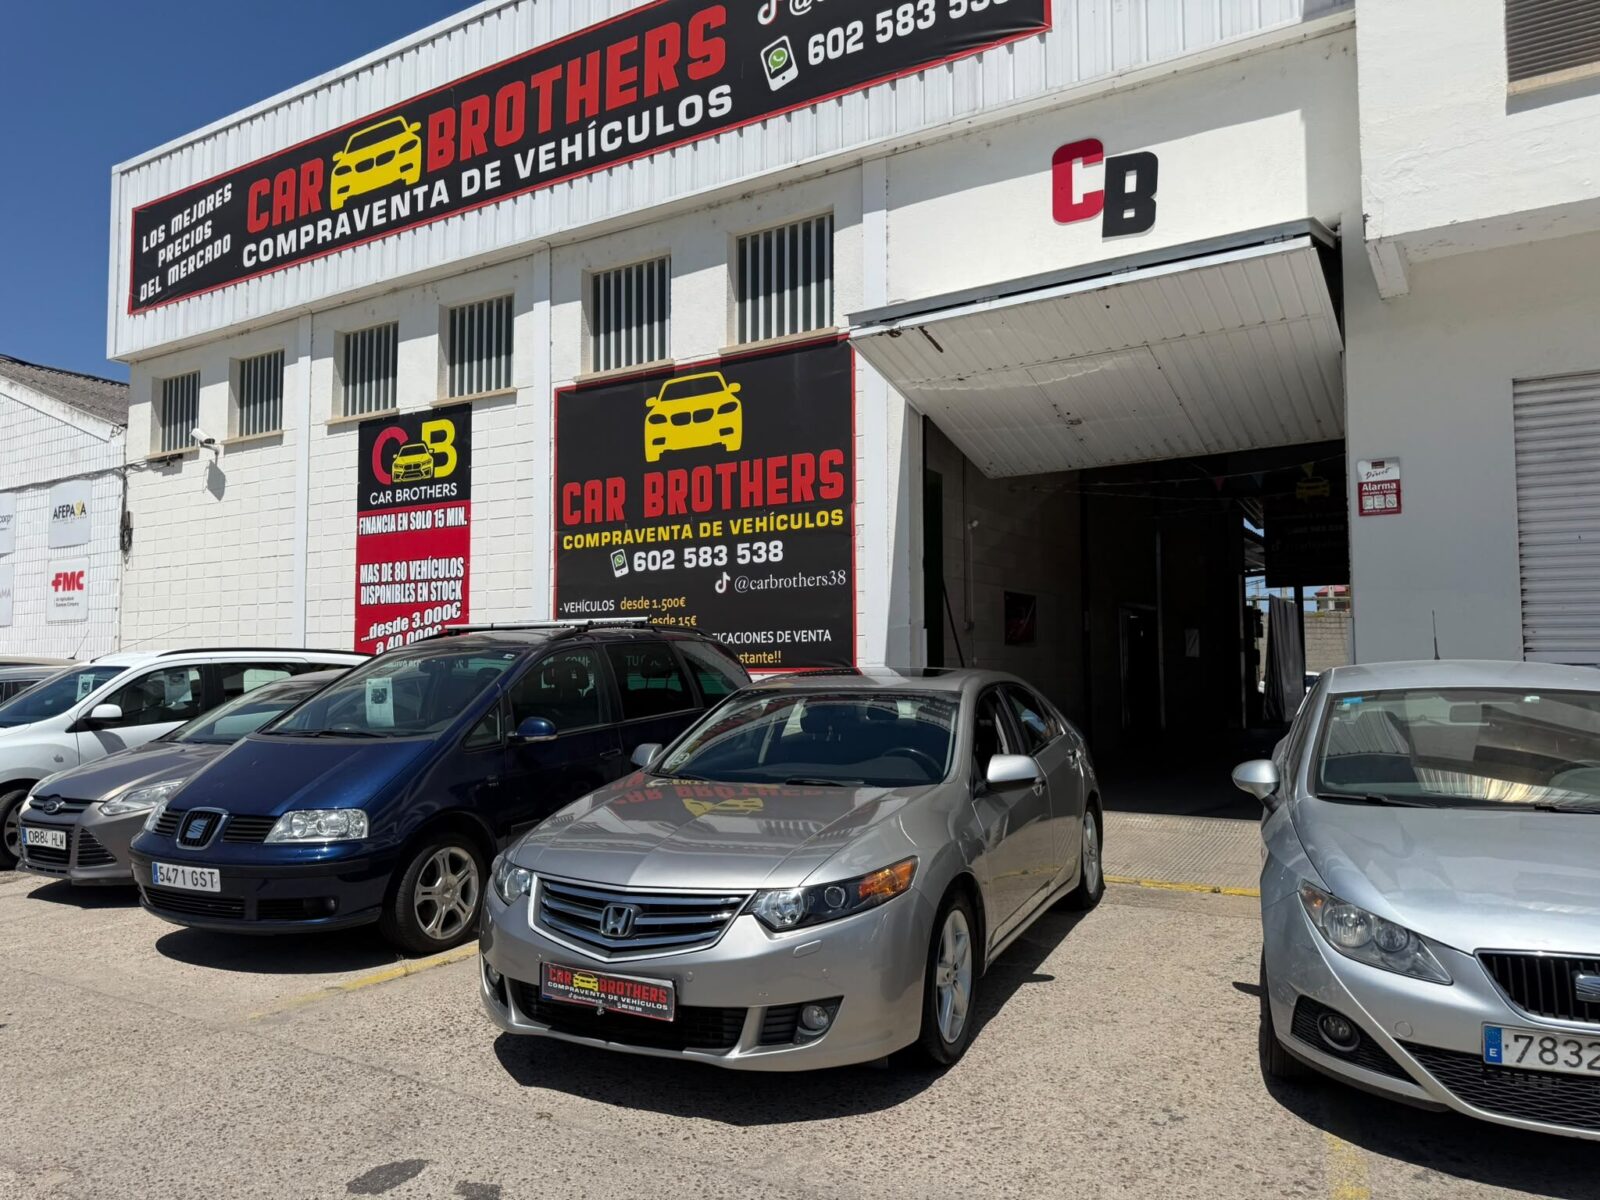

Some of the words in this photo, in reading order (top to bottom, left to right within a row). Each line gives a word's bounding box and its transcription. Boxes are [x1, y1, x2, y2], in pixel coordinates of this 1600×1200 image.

[808, 21, 864, 65] 602
[876, 0, 936, 43] 583
[247, 158, 324, 233] CAR
[427, 5, 726, 172] BROTHERS
[243, 179, 449, 268] COMPRAVENTA
[461, 160, 501, 198] DE
[514, 85, 732, 179] VEHÍCULOS
[142, 224, 166, 253] LOS
[171, 183, 232, 233] MEJORES
[158, 221, 212, 267] PRECIOS
[140, 277, 162, 302] DEL
[168, 234, 231, 286] MERCADO
[370, 491, 392, 505] CAR
[396, 482, 457, 502] BROTHERS
[563, 477, 625, 525] CAR
[644, 449, 844, 518] BROTHERS
[1362, 482, 1397, 491] Alarma
[359, 514, 396, 535] FINANCIA
[398, 512, 409, 531] EN
[410, 510, 432, 530] SOLO
[434, 509, 445, 528] 15
[447, 507, 468, 526] MIN.
[563, 523, 692, 549] COMPRAVENTA
[700, 520, 723, 538] DE
[730, 509, 844, 535] VEHÍCULOS
[633, 550, 675, 571] 602
[684, 545, 728, 568] 583
[737, 540, 783, 564] 538
[51, 570, 85, 592] FMC
[360, 563, 379, 583] MAS
[381, 562, 392, 581] DE
[395, 561, 407, 581] 80
[409, 556, 464, 580] VEHÍCULOS
[734, 570, 846, 593] @carbrothers38
[361, 583, 415, 605] DISPONIBLES
[418, 582, 428, 601] EN
[430, 580, 462, 601] STOCK
[620, 597, 650, 610] desde
[652, 596, 686, 611] 1.500€
[412, 602, 461, 628] 3.000€
[649, 613, 676, 625] esde
[777, 631, 791, 643] DE
[793, 629, 832, 642] VENTA
[736, 650, 782, 664] stante!!
[159, 866, 186, 886] 5471
[191, 870, 215, 888] GST
[547, 981, 606, 999] COMPRAVENTA
[608, 994, 618, 1002] DE
[620, 996, 668, 1010] VEHÍCULOS
[549, 968, 571, 985] CAR
[598, 978, 667, 1003] BROTHERS
[1489, 1047, 1498, 1057] E
